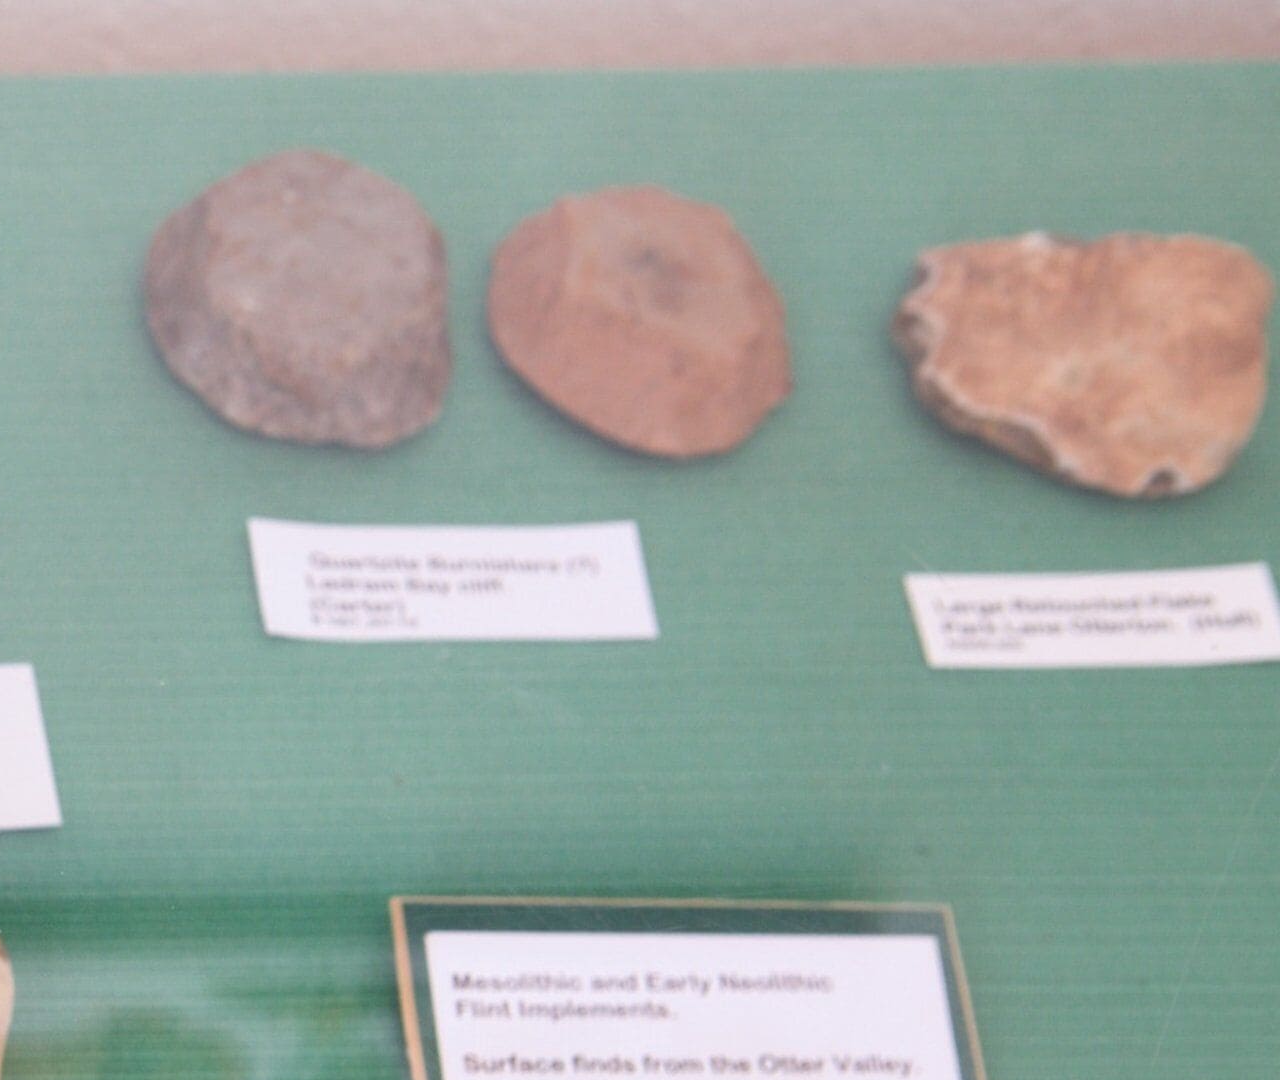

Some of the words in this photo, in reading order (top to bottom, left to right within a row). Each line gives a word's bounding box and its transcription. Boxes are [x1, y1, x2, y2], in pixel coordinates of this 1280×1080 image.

[452, 972, 581, 993] Mesolithic
[592, 972, 638, 993] and
[645, 972, 711, 996] Early
[719, 974, 832, 994] Neolithic
[454, 1000, 511, 1020] Flint
[519, 1000, 678, 1022] Implements.
[463, 1054, 565, 1075] Surface
[572, 1054, 636, 1075] finds
[643, 1055, 703, 1075] from
[710, 1055, 750, 1075] the
[758, 1054, 824, 1075] Otter
